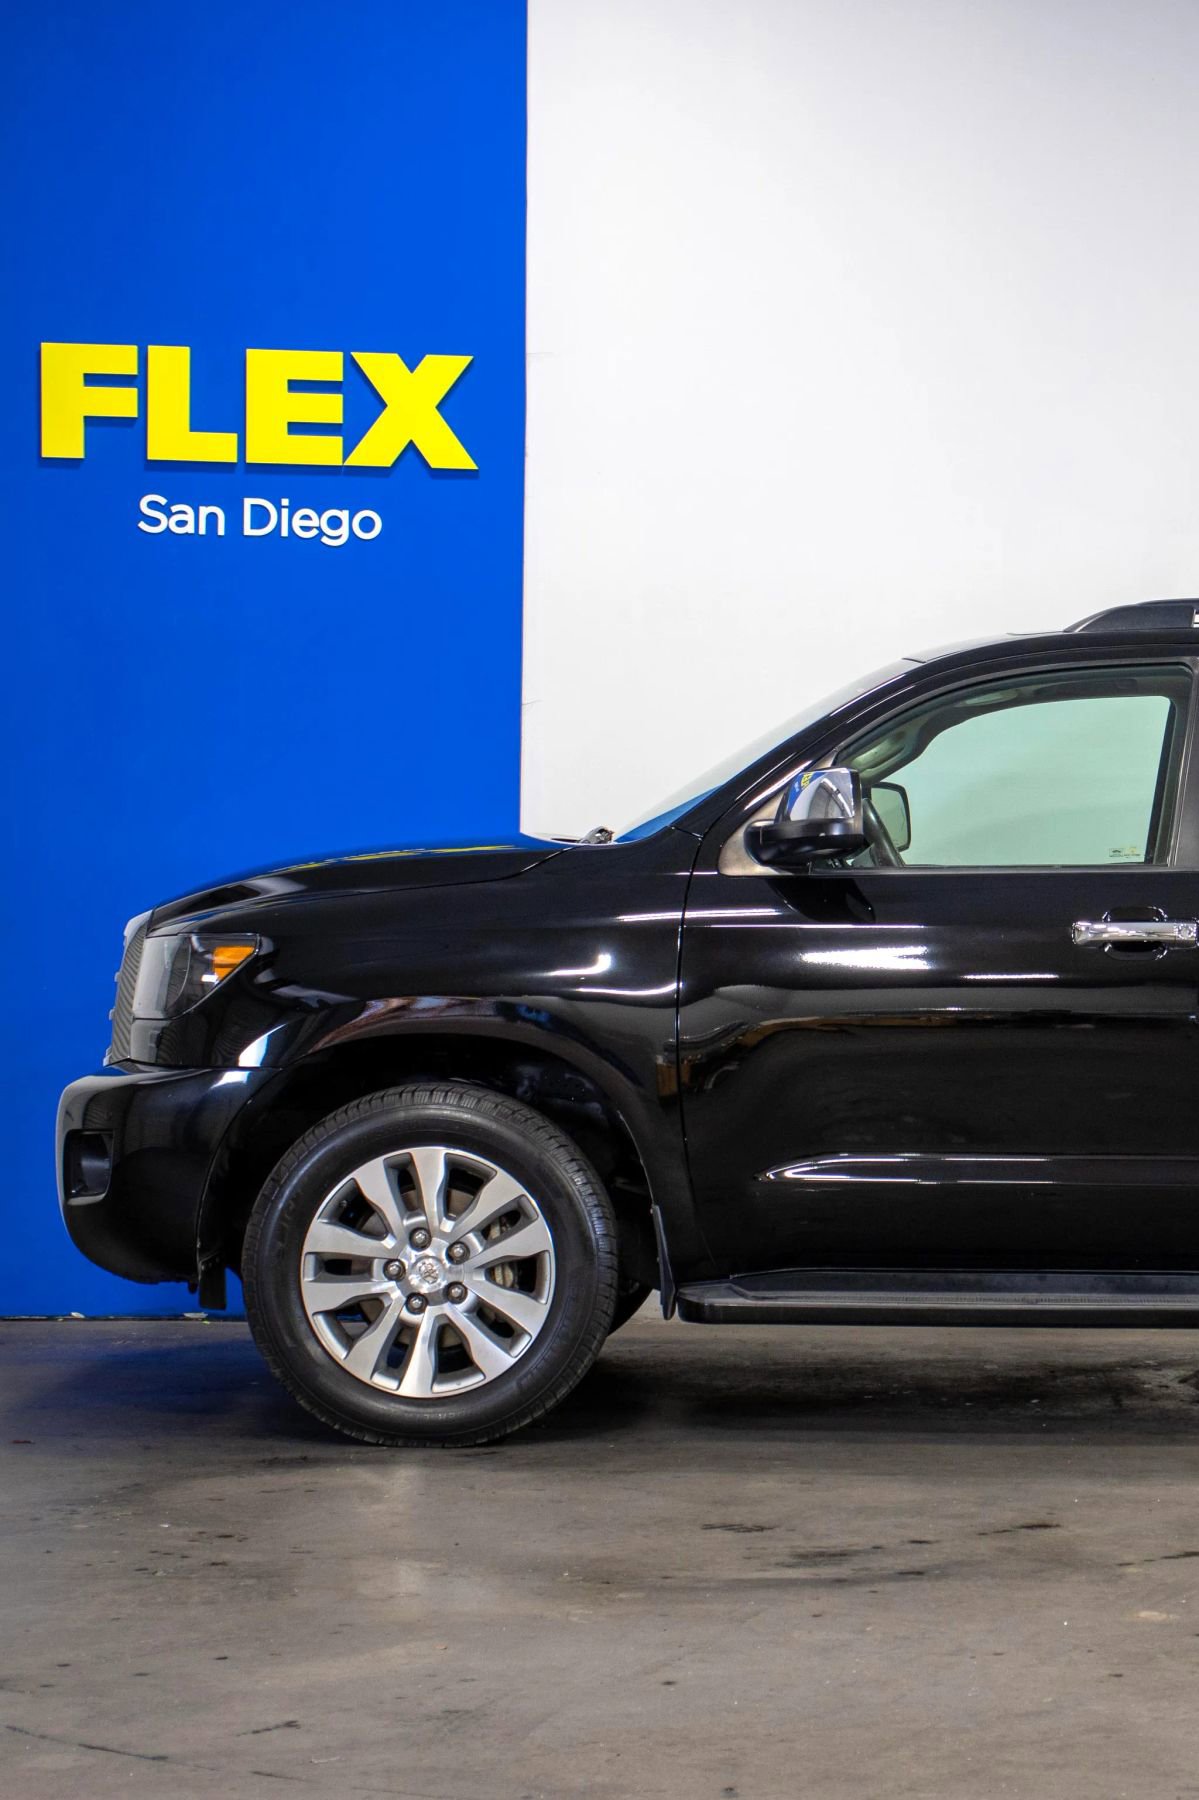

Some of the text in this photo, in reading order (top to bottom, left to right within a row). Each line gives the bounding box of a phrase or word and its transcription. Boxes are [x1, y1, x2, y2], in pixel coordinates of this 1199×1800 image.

[40, 342, 479, 470] FLEX
[137, 494, 383, 547] San Diego
